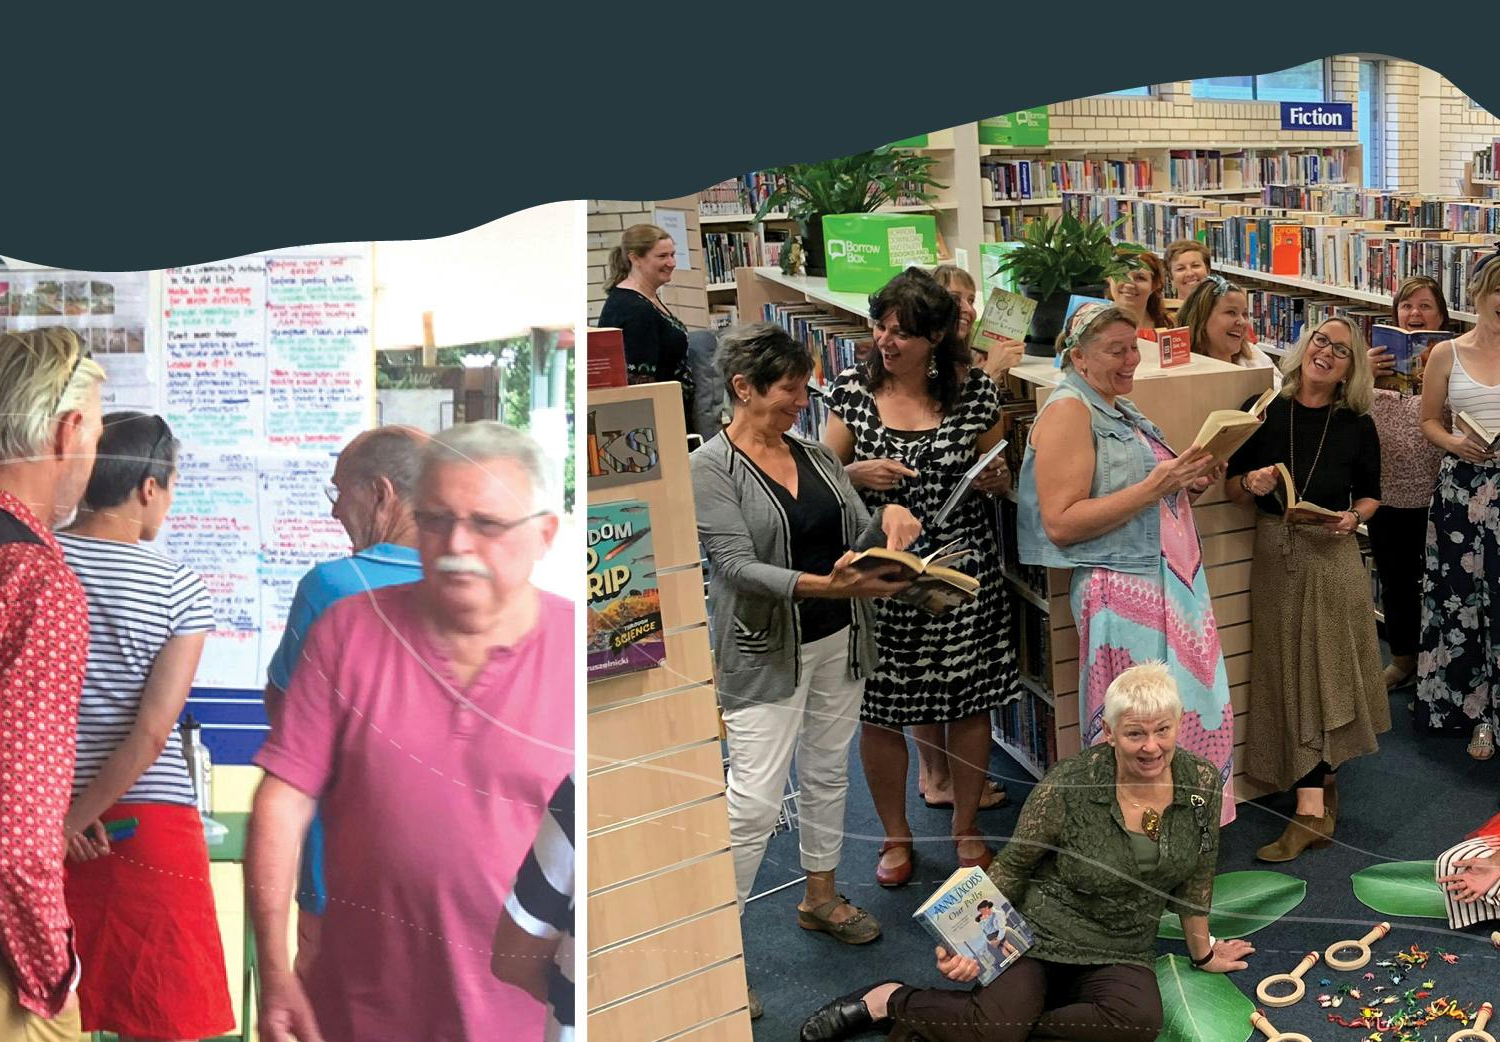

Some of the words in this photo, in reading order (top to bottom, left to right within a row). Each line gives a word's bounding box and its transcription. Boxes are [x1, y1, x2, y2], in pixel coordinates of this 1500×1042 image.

[1290, 107, 1342, 125] Fiction
[846, 240, 880, 254] Borrow
[847, 252, 867, 264] Box.
[624, 618, 648, 631] THROUGH
[614, 621, 656, 648] SCIENCE
[934, 894, 959, 914] ANNA
[956, 872, 983, 903] JACOBS
[948, 906, 964, 921] Our
[965, 890, 983, 909] Polly
